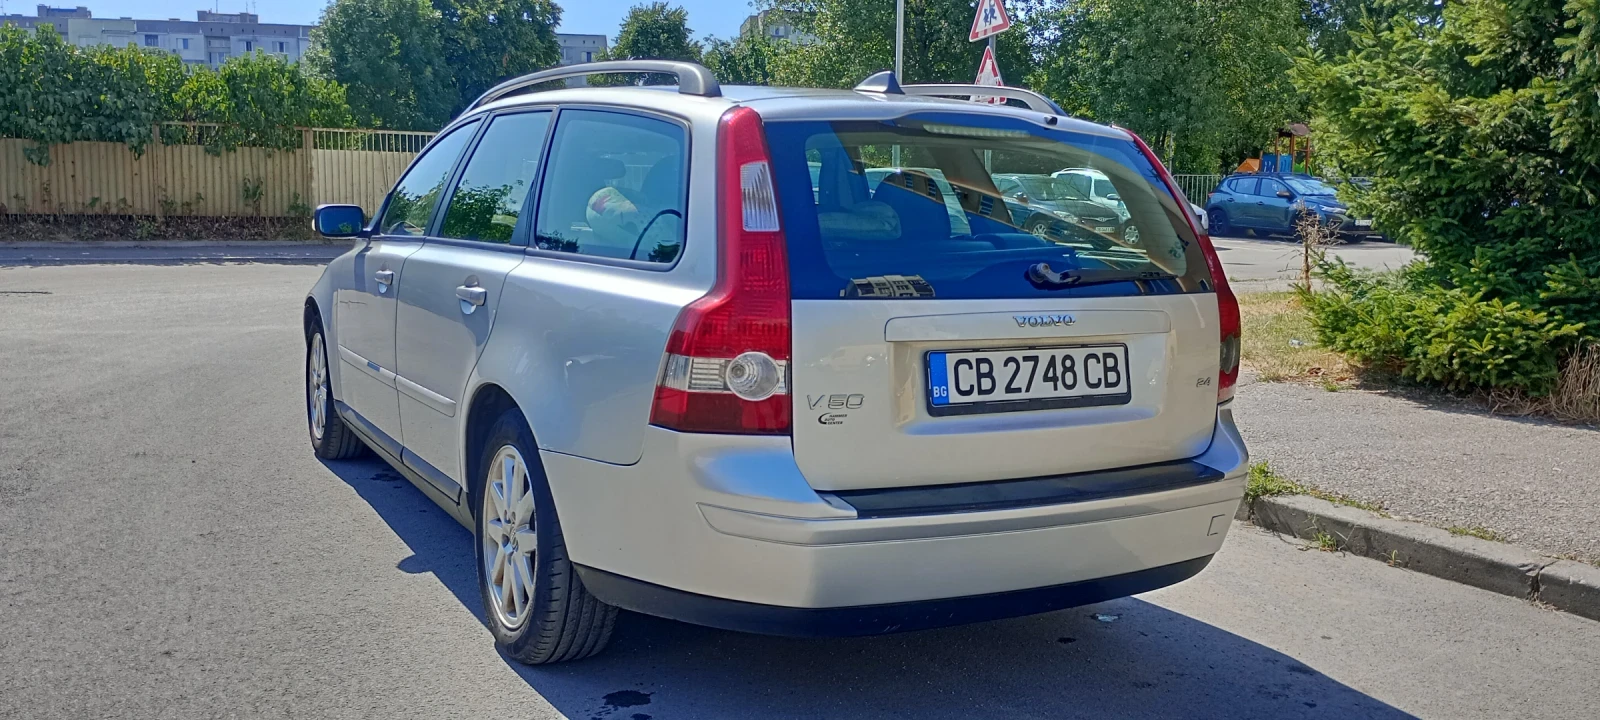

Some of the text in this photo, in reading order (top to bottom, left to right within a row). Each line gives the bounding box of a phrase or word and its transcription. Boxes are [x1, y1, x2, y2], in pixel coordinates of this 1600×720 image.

[1012, 314, 1076, 328] VOLVO
[953, 352, 1121, 397] CB 2748 CB
[932, 385, 948, 398] BG
